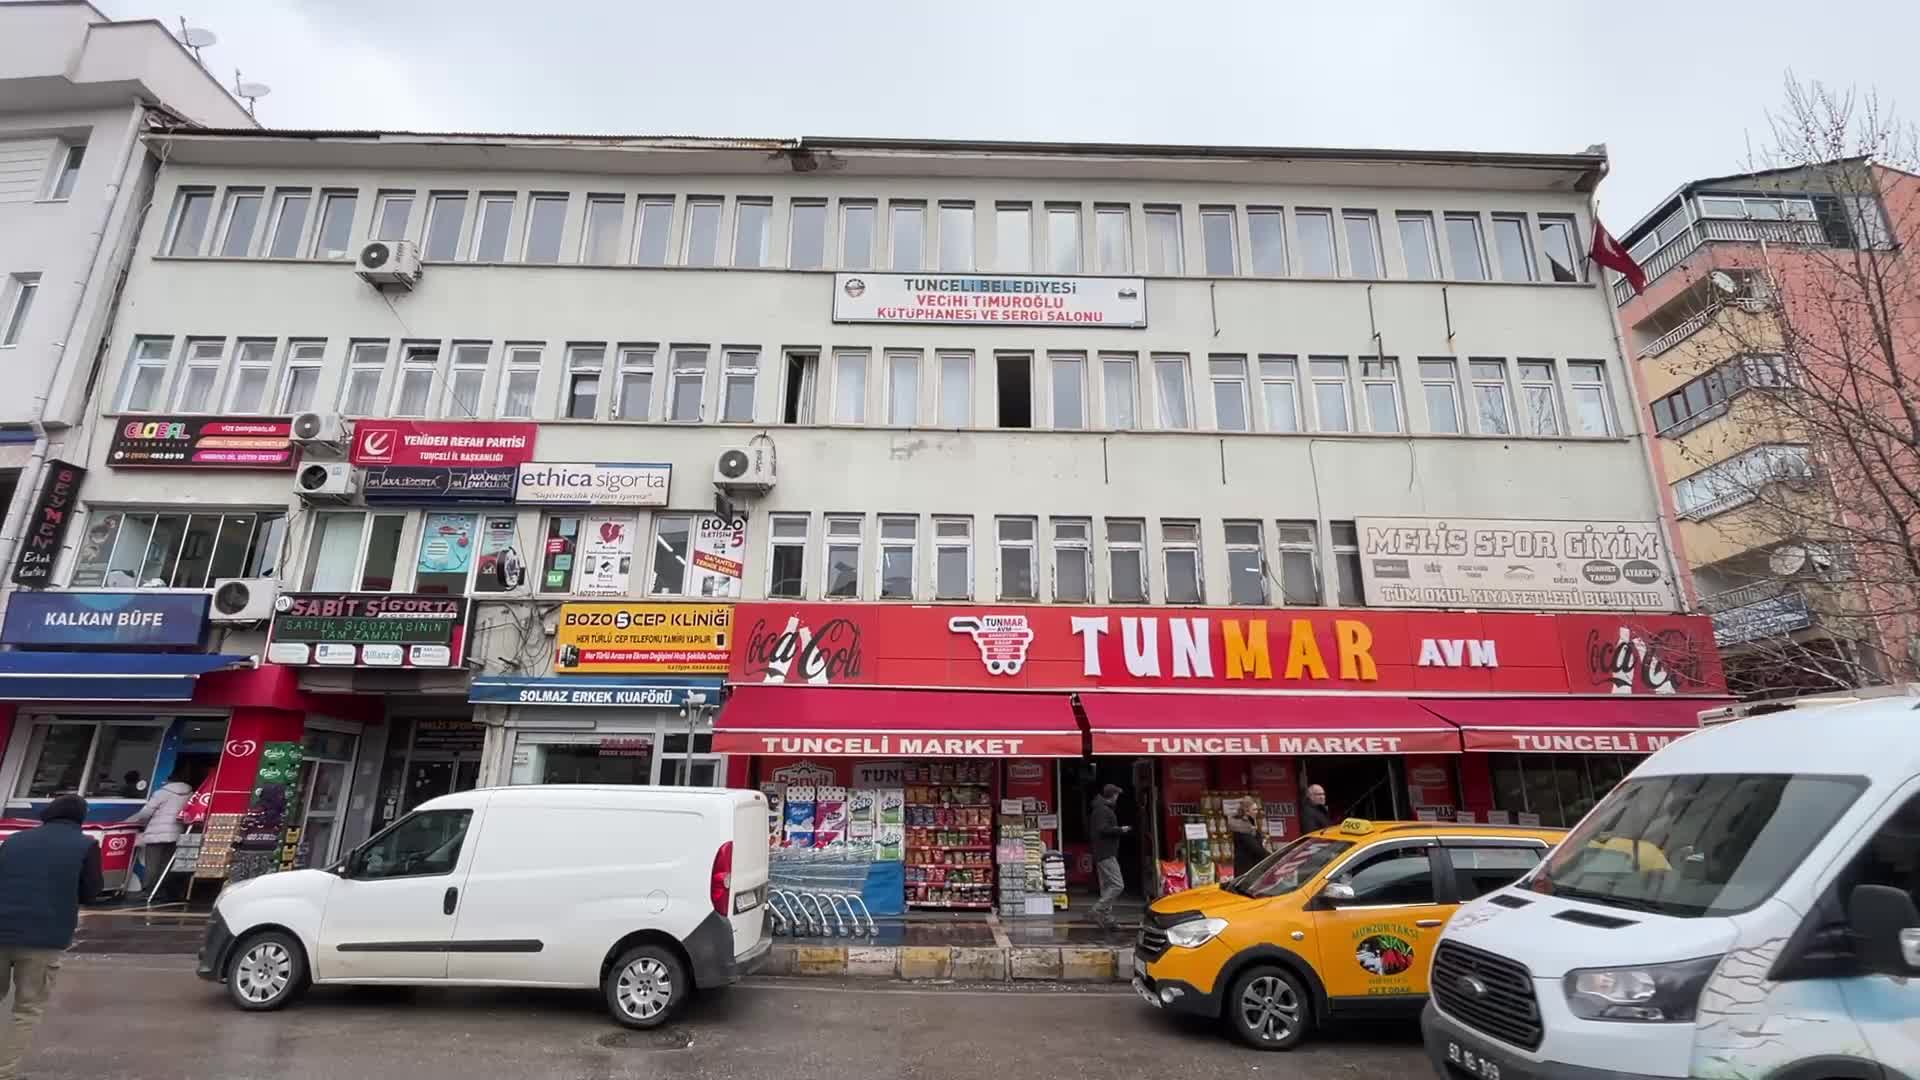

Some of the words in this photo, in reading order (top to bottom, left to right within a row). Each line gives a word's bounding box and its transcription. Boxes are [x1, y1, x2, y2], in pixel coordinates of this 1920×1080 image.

[904, 278, 976, 293] TUNCELİ
[980, 279, 1077, 294] BELEDİYESİ
[917, 294, 969, 307] VECİHİ
[972, 294, 1064, 309] TİMUROĞLU
[877, 307, 977, 320] KÜTÜPHANESİ
[981, 309, 999, 320] VE
[1002, 310, 1044, 321] SERGİ
[1047, 311, 1103, 322] SALONU
[124, 422, 191, 439] GLOBAL
[404, 432, 449, 447] YENİDEN
[450, 436, 485, 447] REFAH
[486, 434, 526, 448] PARTİSİ
[521, 467, 592, 487] ethica
[596, 471, 665, 493] sigorta
[1366, 522, 1468, 556] MELİS
[1474, 529, 1558, 558] SPOR
[1564, 524, 1659, 559] GİYİM
[1380, 583, 1423, 602] TÜM
[1424, 589, 1467, 603] OKUL
[1471, 586, 1582, 606] KIYAFETLERİ
[1584, 590, 1663, 606] BULUNUR
[290, 597, 358, 616] SABİT
[364, 597, 459, 616] SİGORTA
[45, 612, 113, 626] KALKAN
[117, 609, 164, 626] BÜFE
[565, 613, 613, 626] BOZO
[615, 612, 631, 628] 5
[632, 613, 666, 626] CEP
[671, 609, 729, 627] KLİNİĞİ
[985, 618, 1024, 627] TUNMAR
[320, 630, 347, 640] TAM
[1071, 616, 1378, 680] TUNMAR
[1417, 639, 1499, 668] AVM
[519, 690, 569, 703] SOLMAZ
[572, 690, 612, 703] ERKEK
[616, 688, 673, 703] KUAFÖRÜ
[761, 736, 889, 754] TUNCELİ
[899, 738, 1024, 755] MARKET
[1142, 735, 1269, 753] TUNCELİ
[1279, 737, 1402, 754] MARKET
[1512, 732, 1639, 751] TUNCELİ
